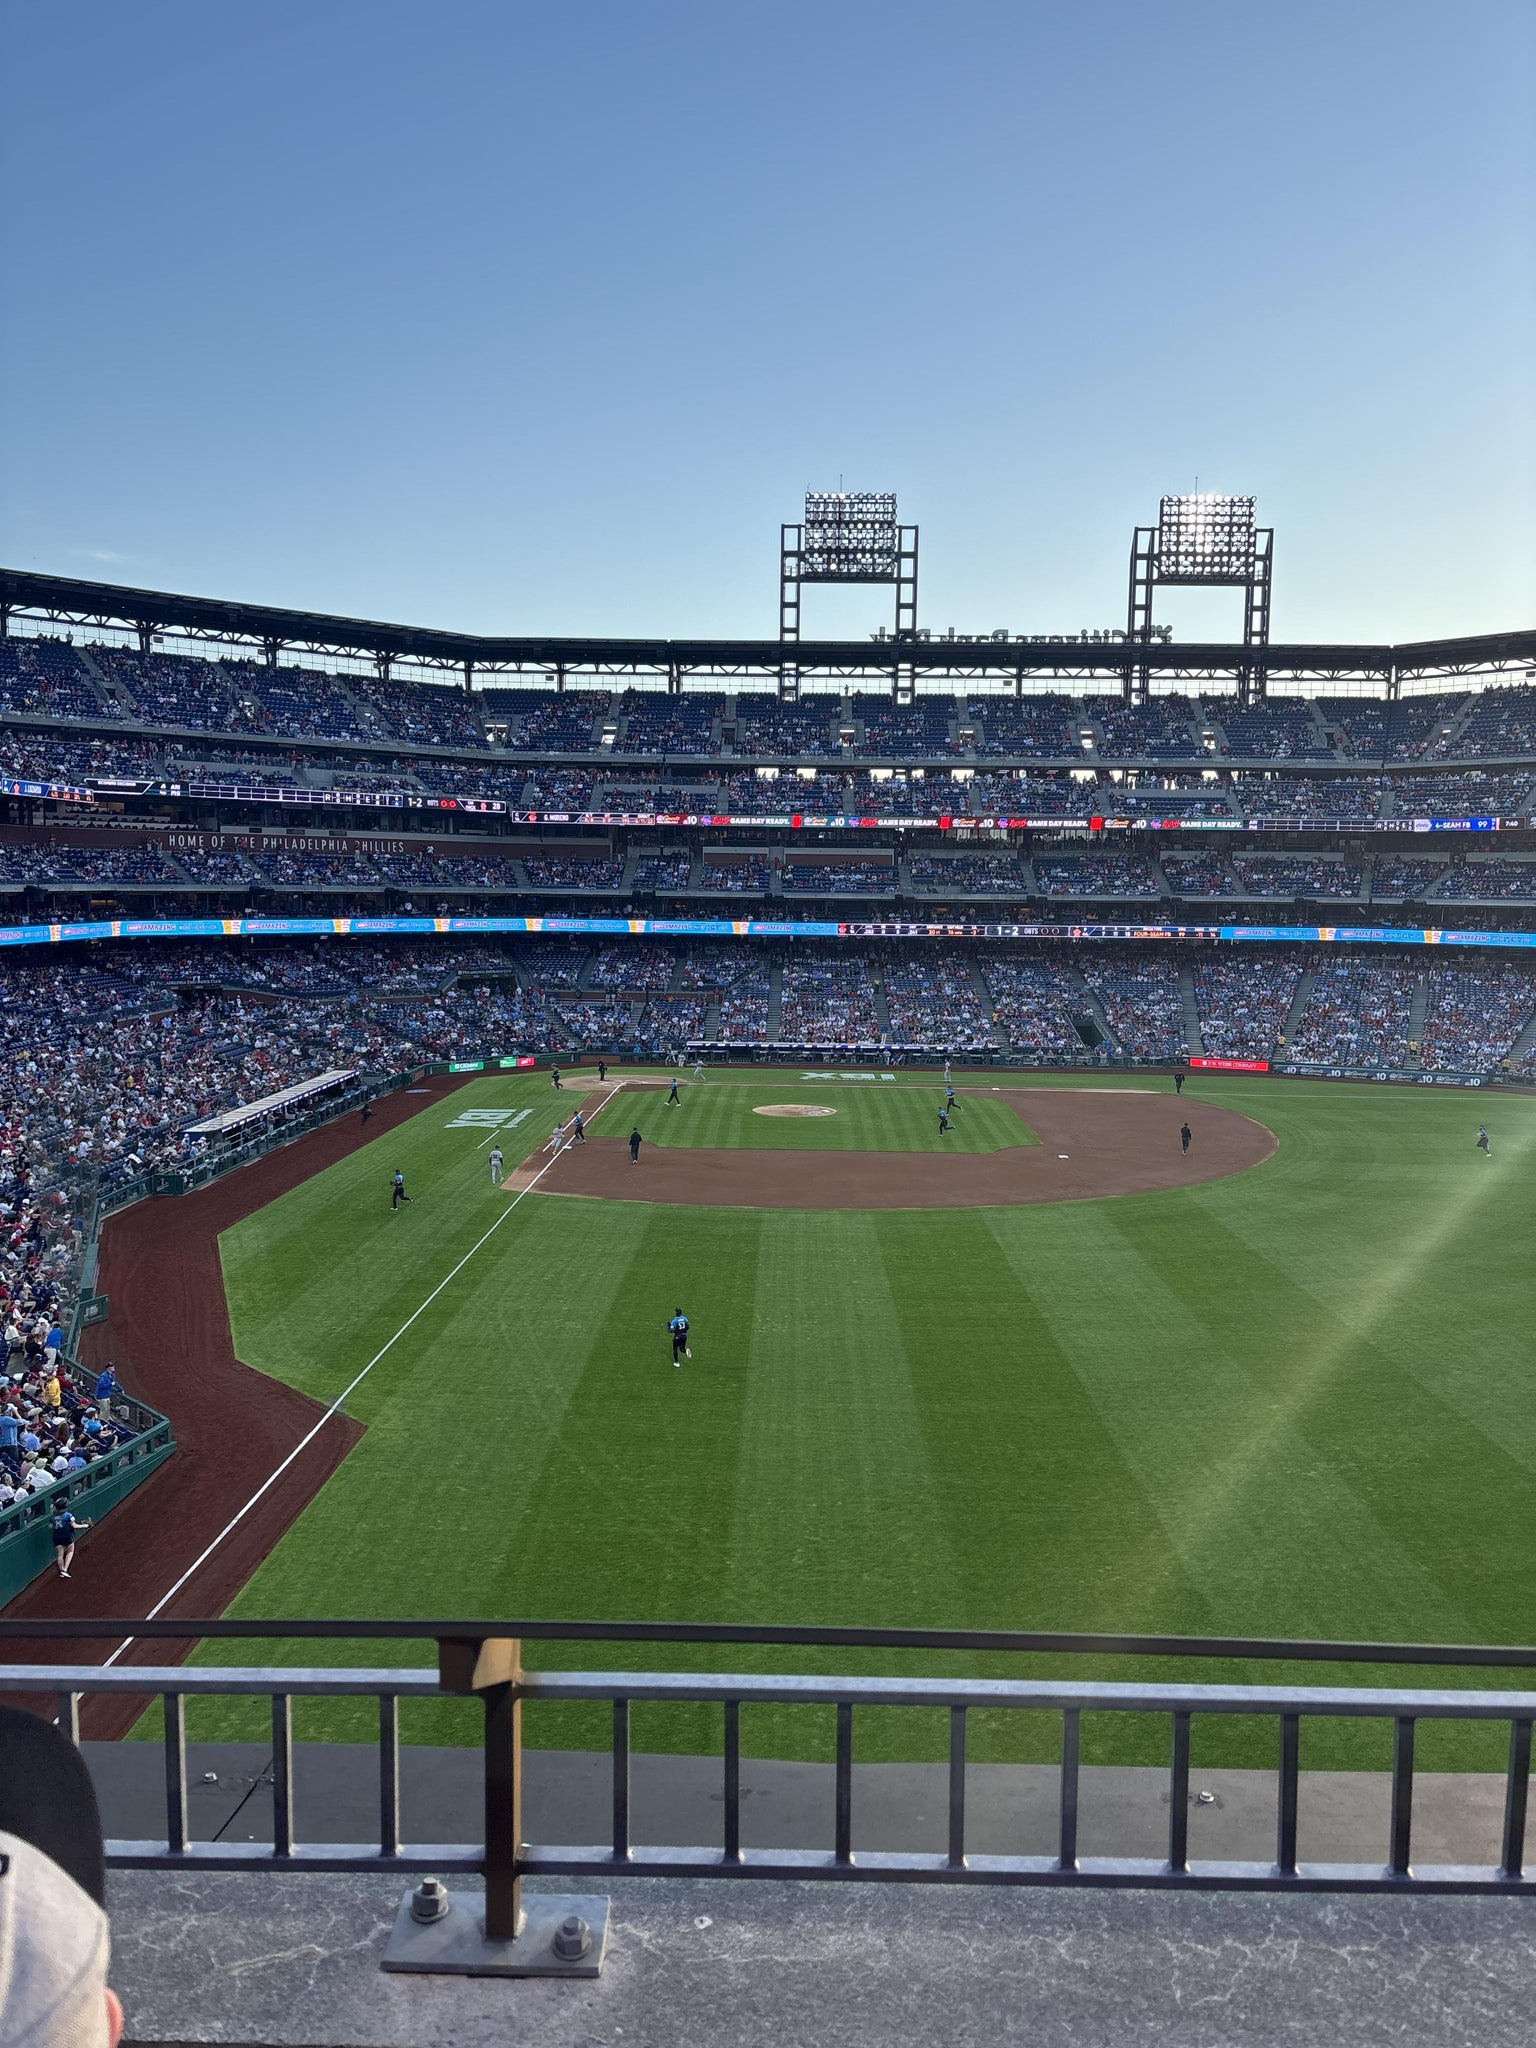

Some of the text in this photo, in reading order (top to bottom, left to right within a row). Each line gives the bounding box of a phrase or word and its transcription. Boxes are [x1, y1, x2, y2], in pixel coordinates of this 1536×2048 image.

[408, 798, 422, 808] 1-2
[687, 816, 697, 824] 10
[835, 818, 845, 826] 10
[984, 819, 994, 827] 10
[1136, 820, 1146, 828] 10
[169, 835, 204, 847] HOME
[212, 836, 225, 847] OF
[263, 838, 348, 850] PHILADELPHIA
[1423, 1075, 1432, 1083] 10
[1469, 1078, 1480, 1086] 10
